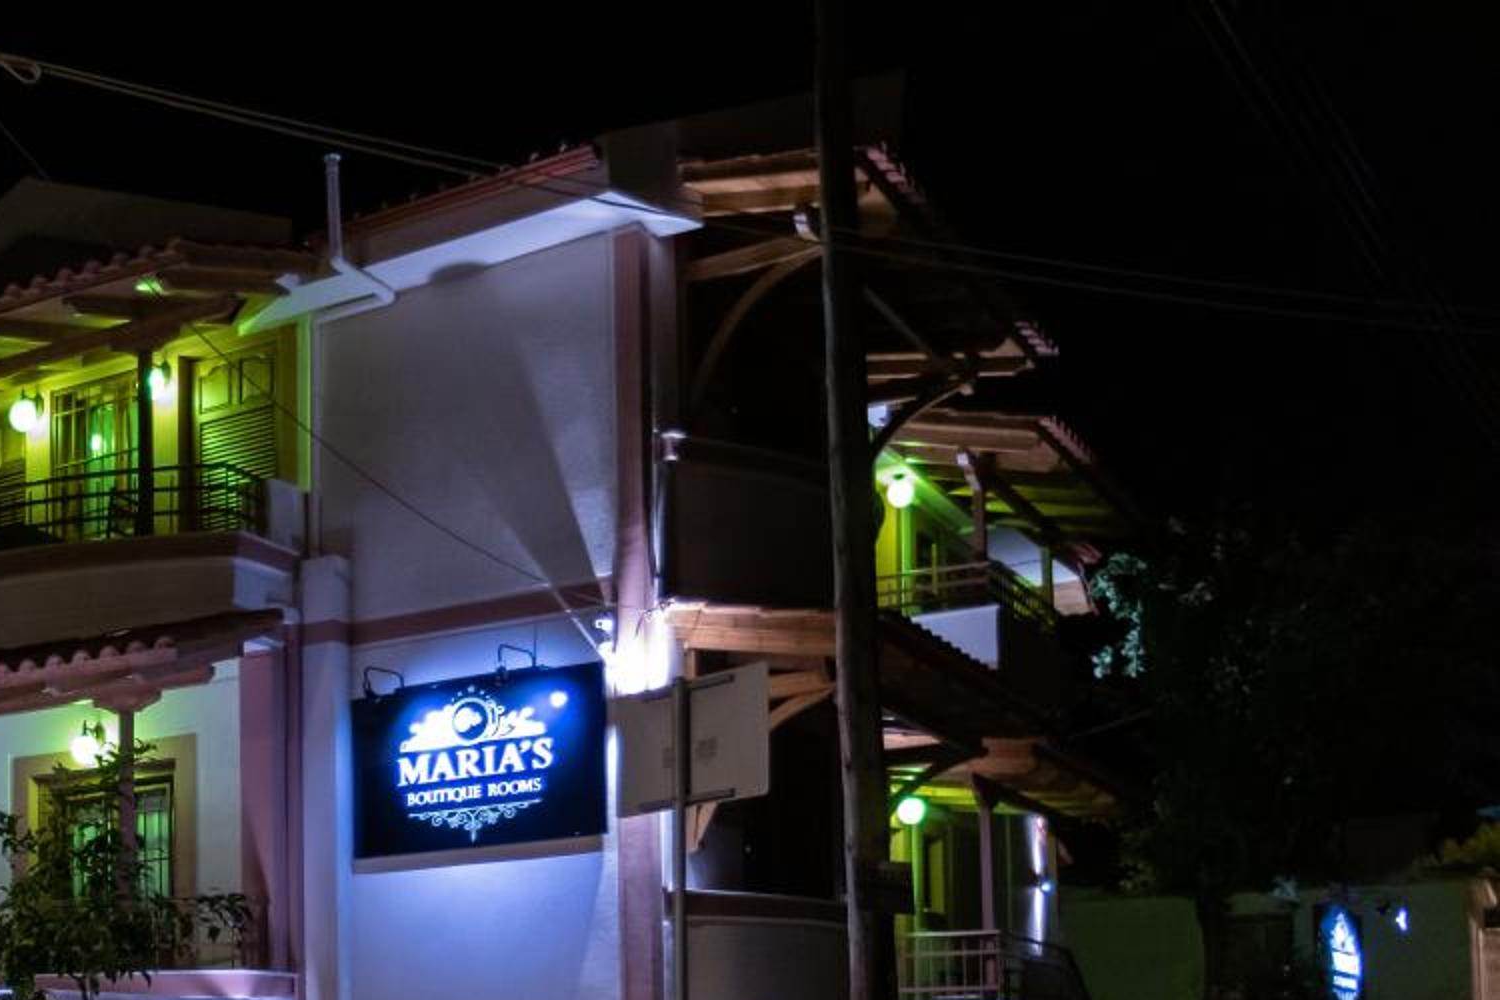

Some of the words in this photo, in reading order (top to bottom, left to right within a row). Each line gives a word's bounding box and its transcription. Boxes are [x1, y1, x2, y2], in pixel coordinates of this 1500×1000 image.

[397, 737, 553, 787] MARIA'S
[407, 784, 482, 807] BOUTIQUE
[487, 778, 542, 798] ROOMS
